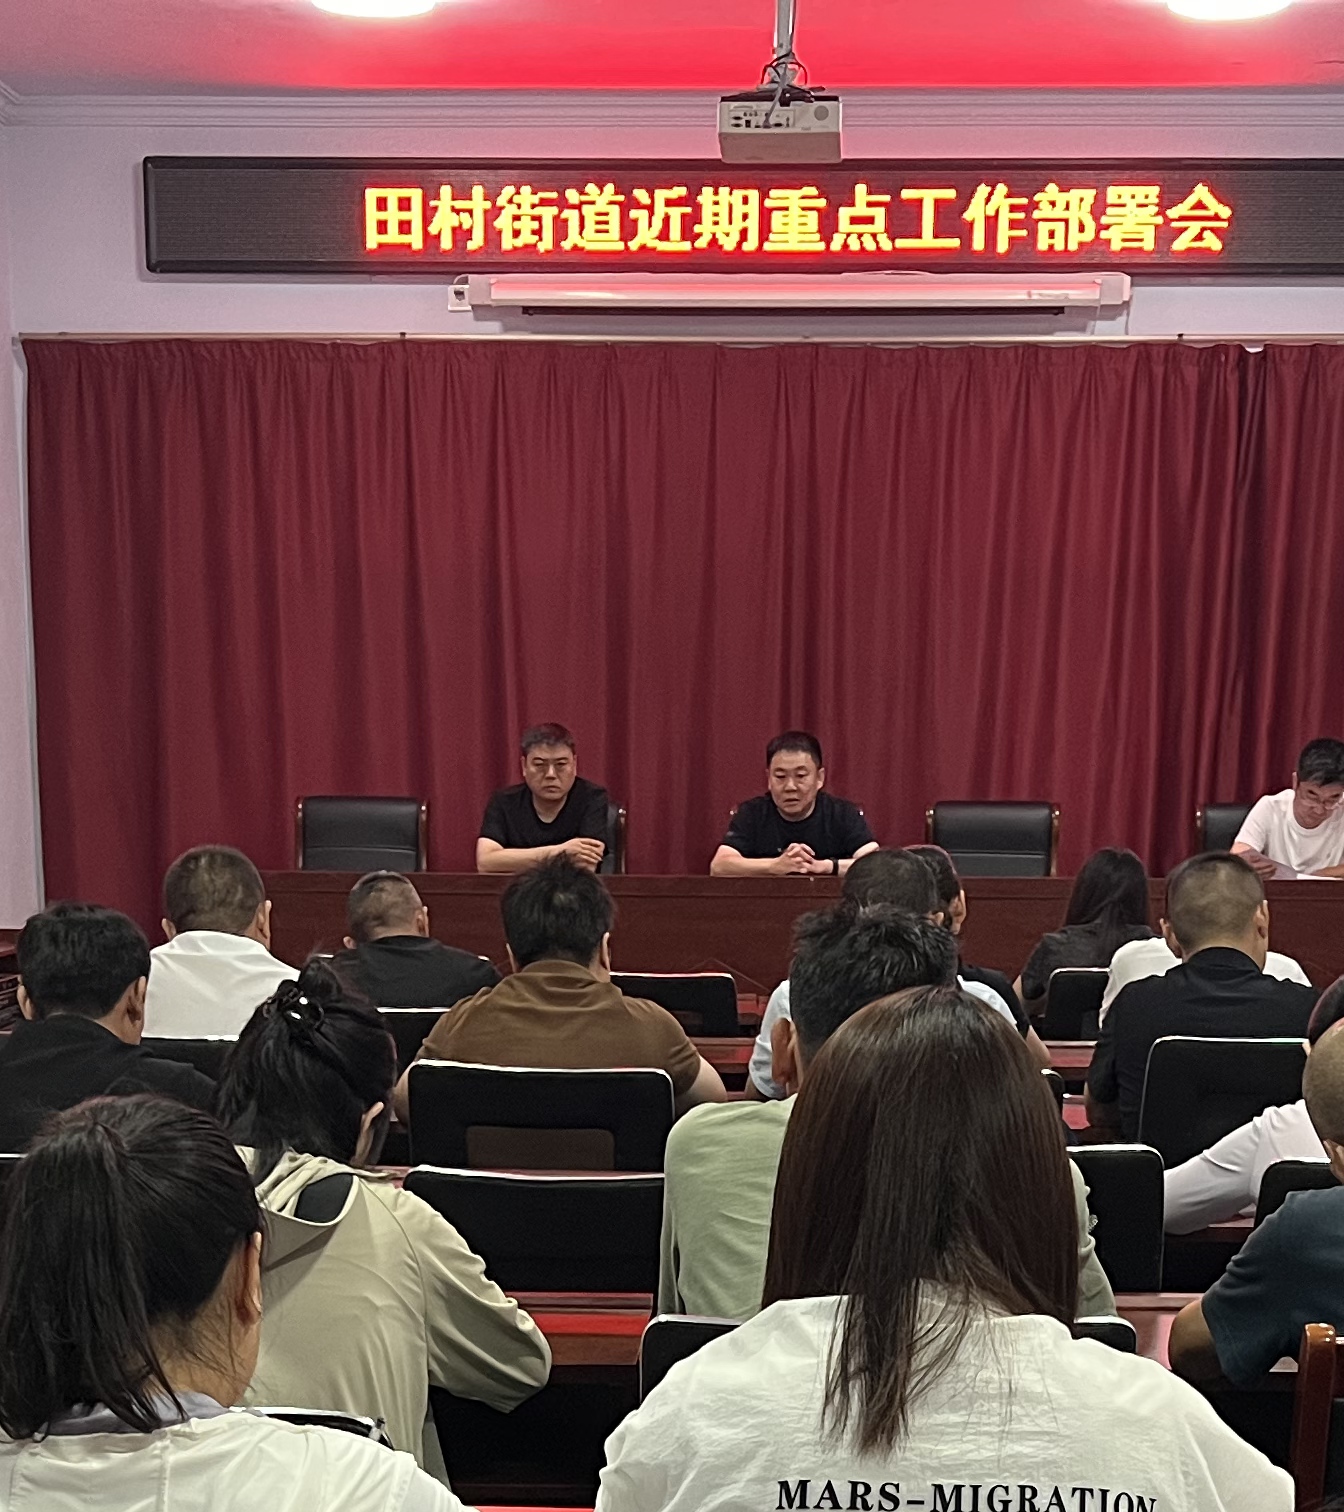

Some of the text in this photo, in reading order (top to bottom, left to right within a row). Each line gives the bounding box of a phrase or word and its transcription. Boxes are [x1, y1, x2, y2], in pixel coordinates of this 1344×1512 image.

[365, 182, 1233, 254] 田村街道近期重点工作部署会
